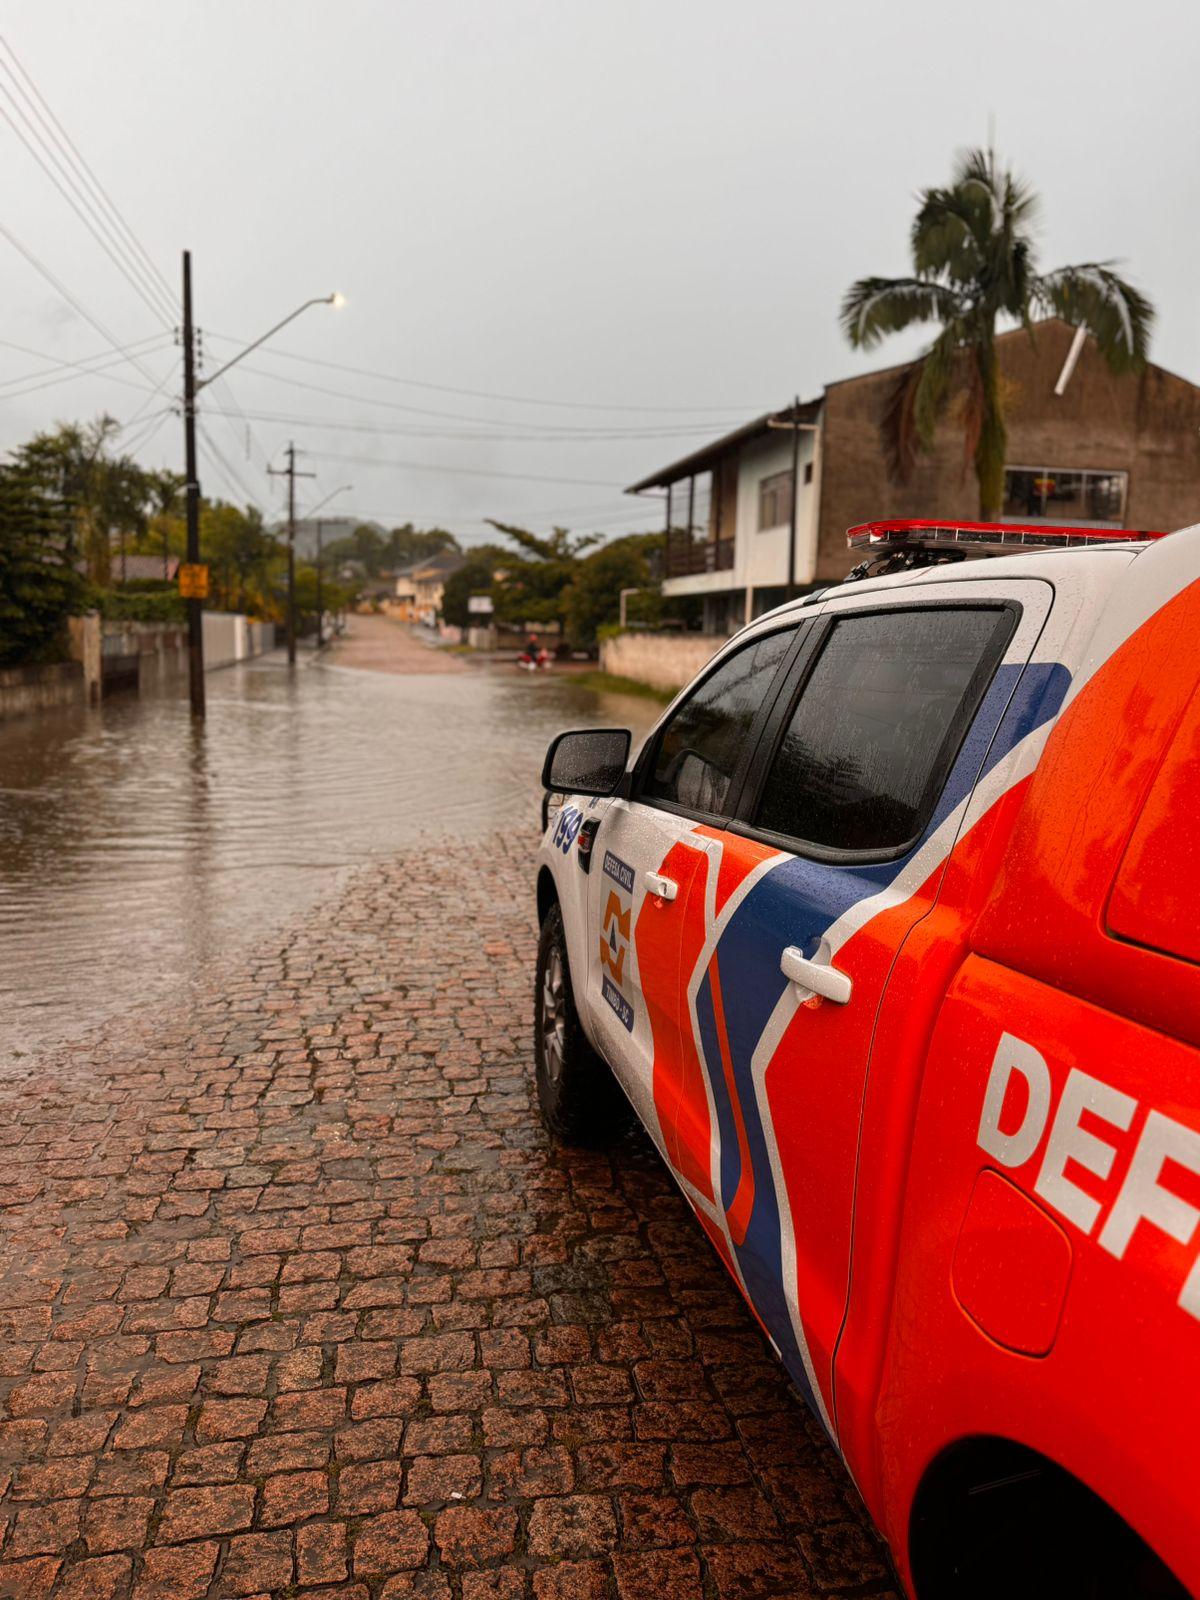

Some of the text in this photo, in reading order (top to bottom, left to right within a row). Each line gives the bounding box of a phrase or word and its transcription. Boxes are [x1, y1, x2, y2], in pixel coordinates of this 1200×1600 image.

[553, 806, 583, 854] 199
[604, 854, 632, 889] DEFESA CIVIL
[976, 1031, 1200, 1322] DEF
